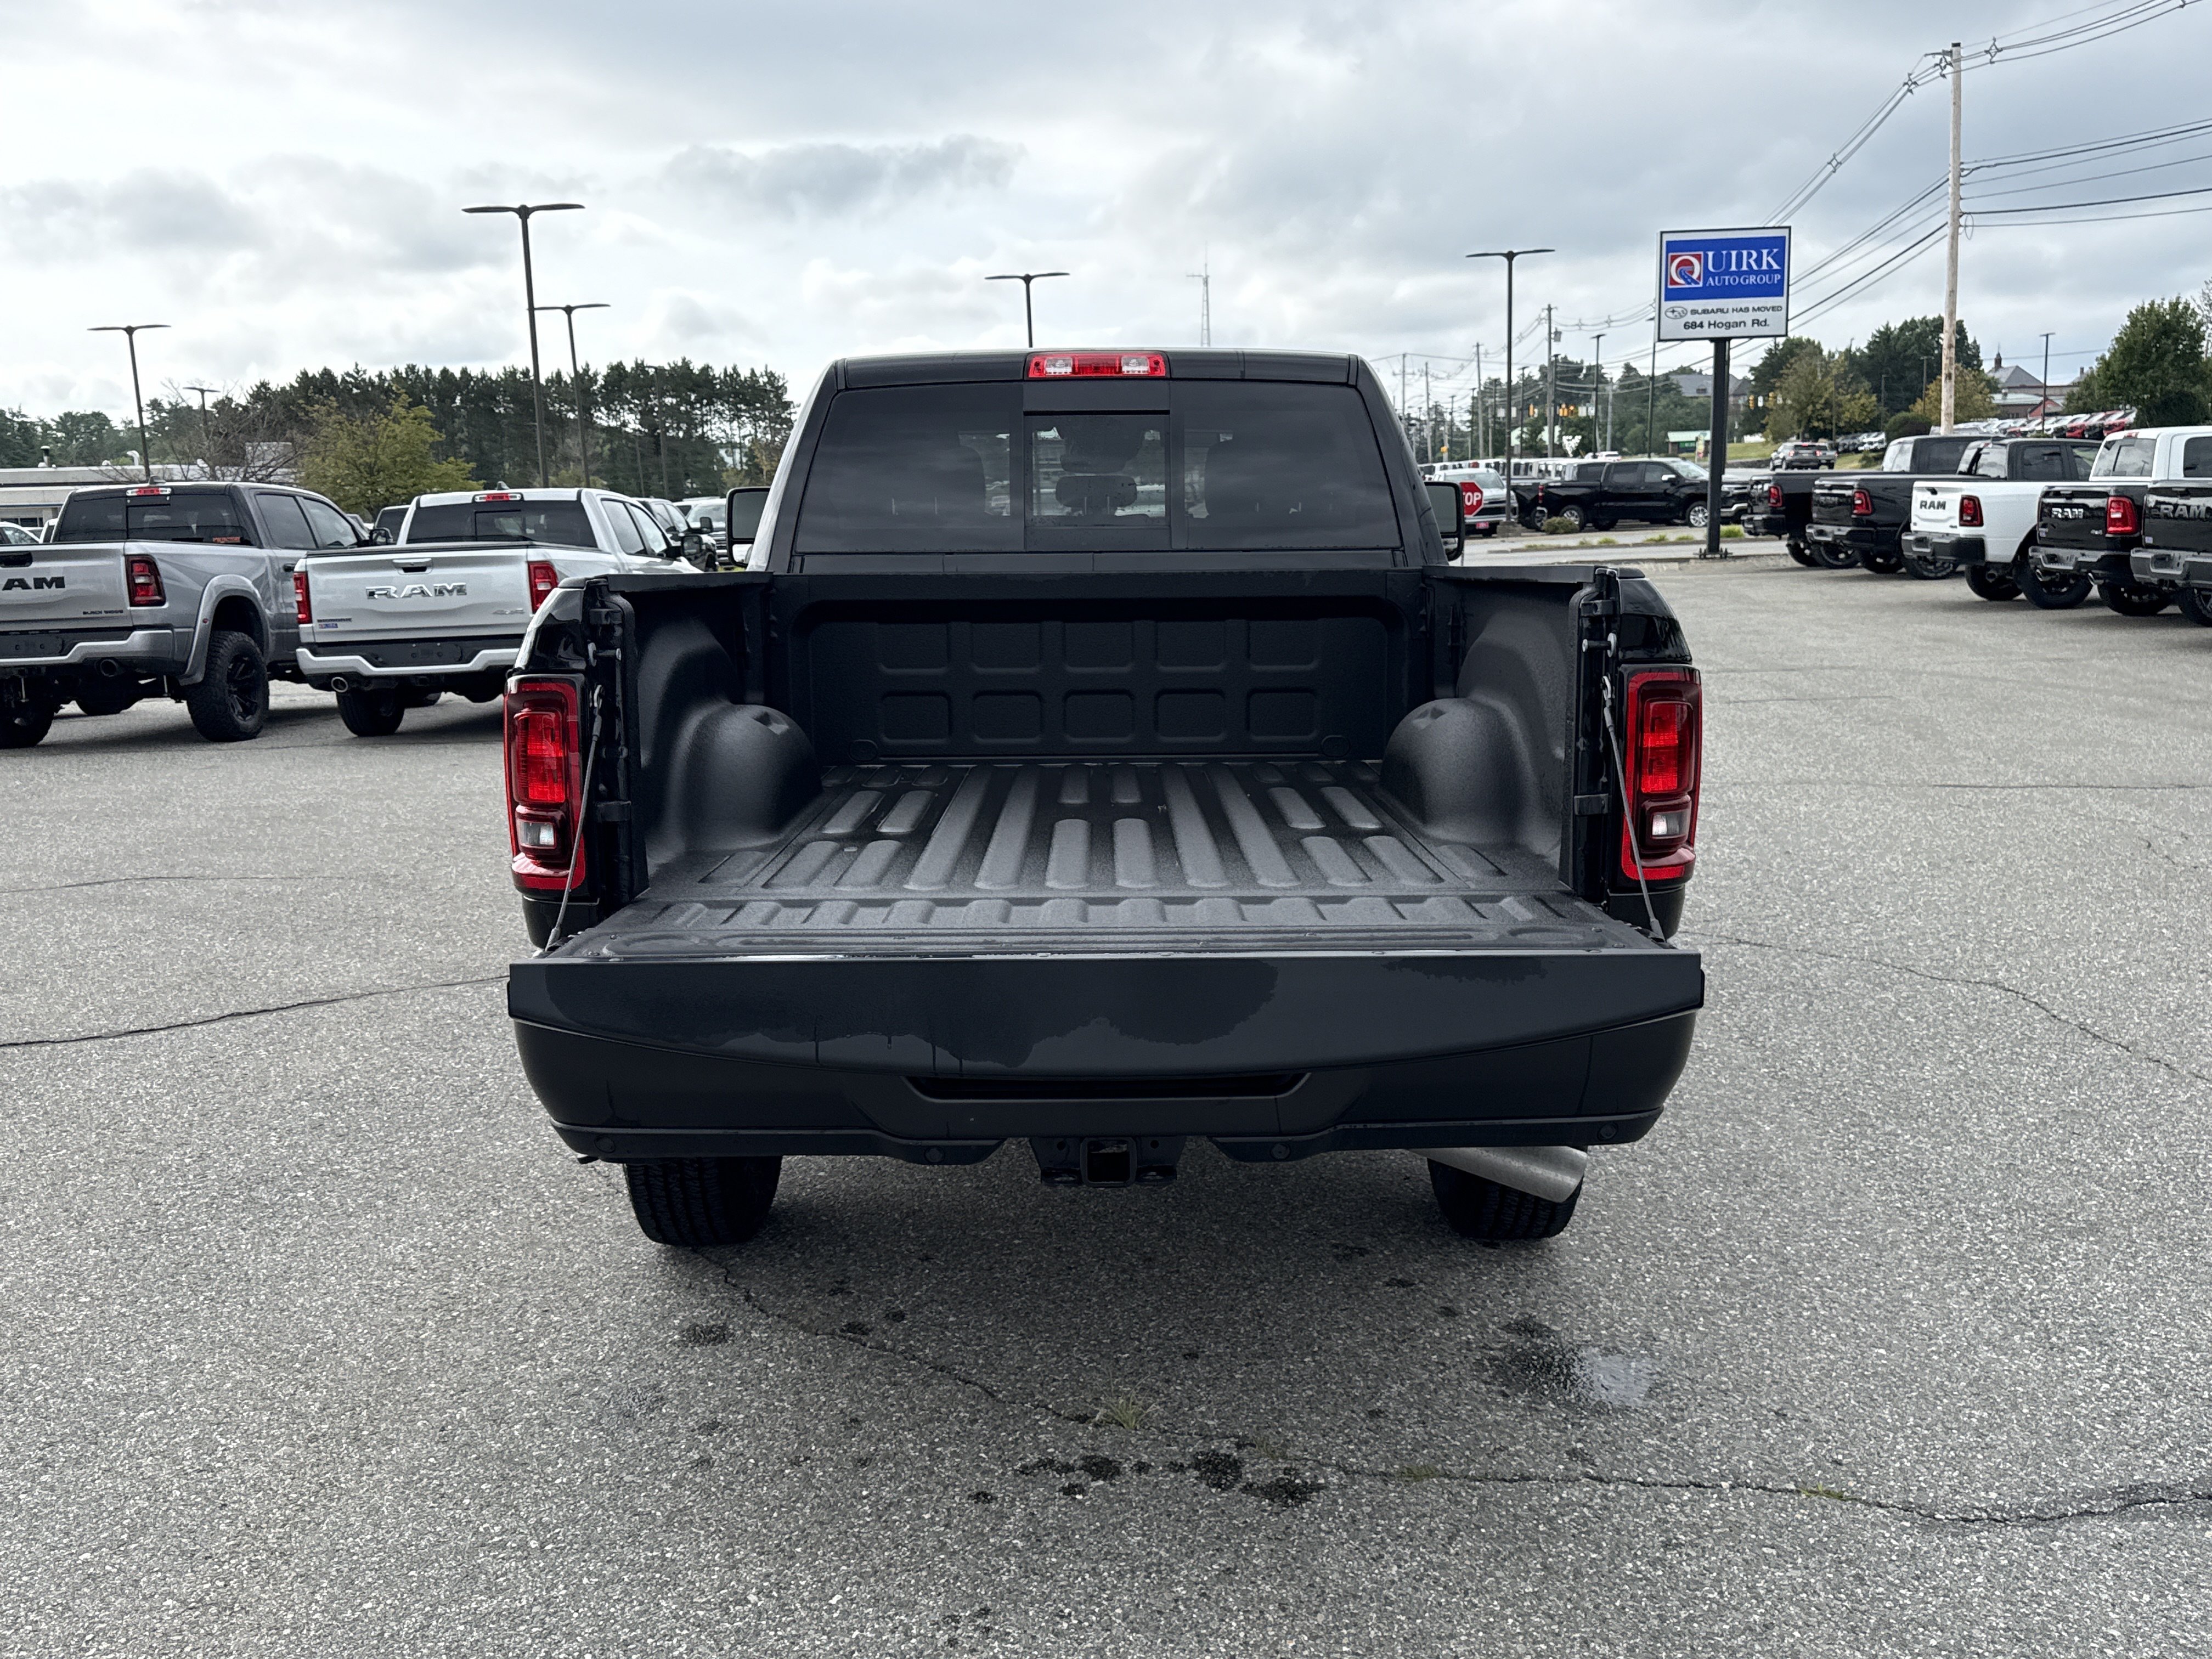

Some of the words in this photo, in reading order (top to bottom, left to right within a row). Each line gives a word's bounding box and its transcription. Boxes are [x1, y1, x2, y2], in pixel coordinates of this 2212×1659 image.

[1671, 249, 1782, 285] QUIRK
[1706, 275, 1739, 286] AUTO
[1740, 274, 1781, 285] GROUP
[1683, 321, 1704, 330] 684
[1708, 320, 1747, 330] Hogan
[1751, 318, 1770, 328] Rd.
[1462, 492, 1482, 506] OP
[1920, 500, 1946, 510] RAM
[2160, 505, 2207, 518] RAM
[2, 576, 66, 591] AM
[365, 582, 467, 599] RAM
